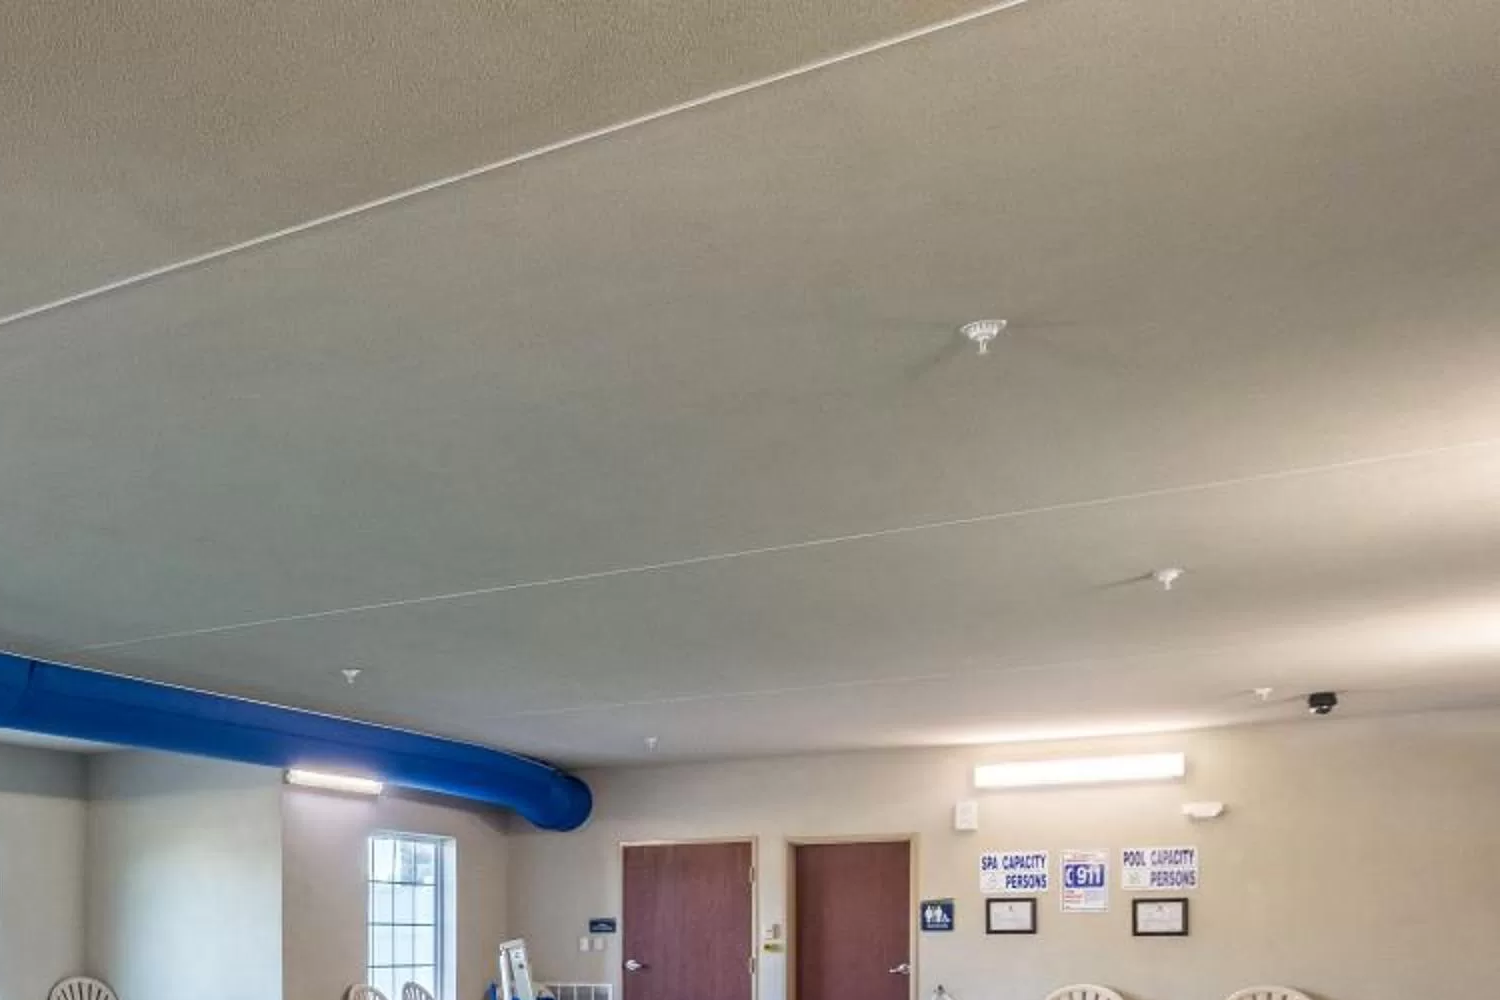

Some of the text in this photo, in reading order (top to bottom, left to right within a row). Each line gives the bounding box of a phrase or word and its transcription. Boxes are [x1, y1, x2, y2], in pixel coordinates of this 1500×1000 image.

[981, 854, 1046, 870] SPA CAPACITY
[1123, 849, 1194, 867] POOL CAPACITY
[1005, 874, 1047, 888] PERSONS
[1150, 870, 1196, 886] PERSONS
